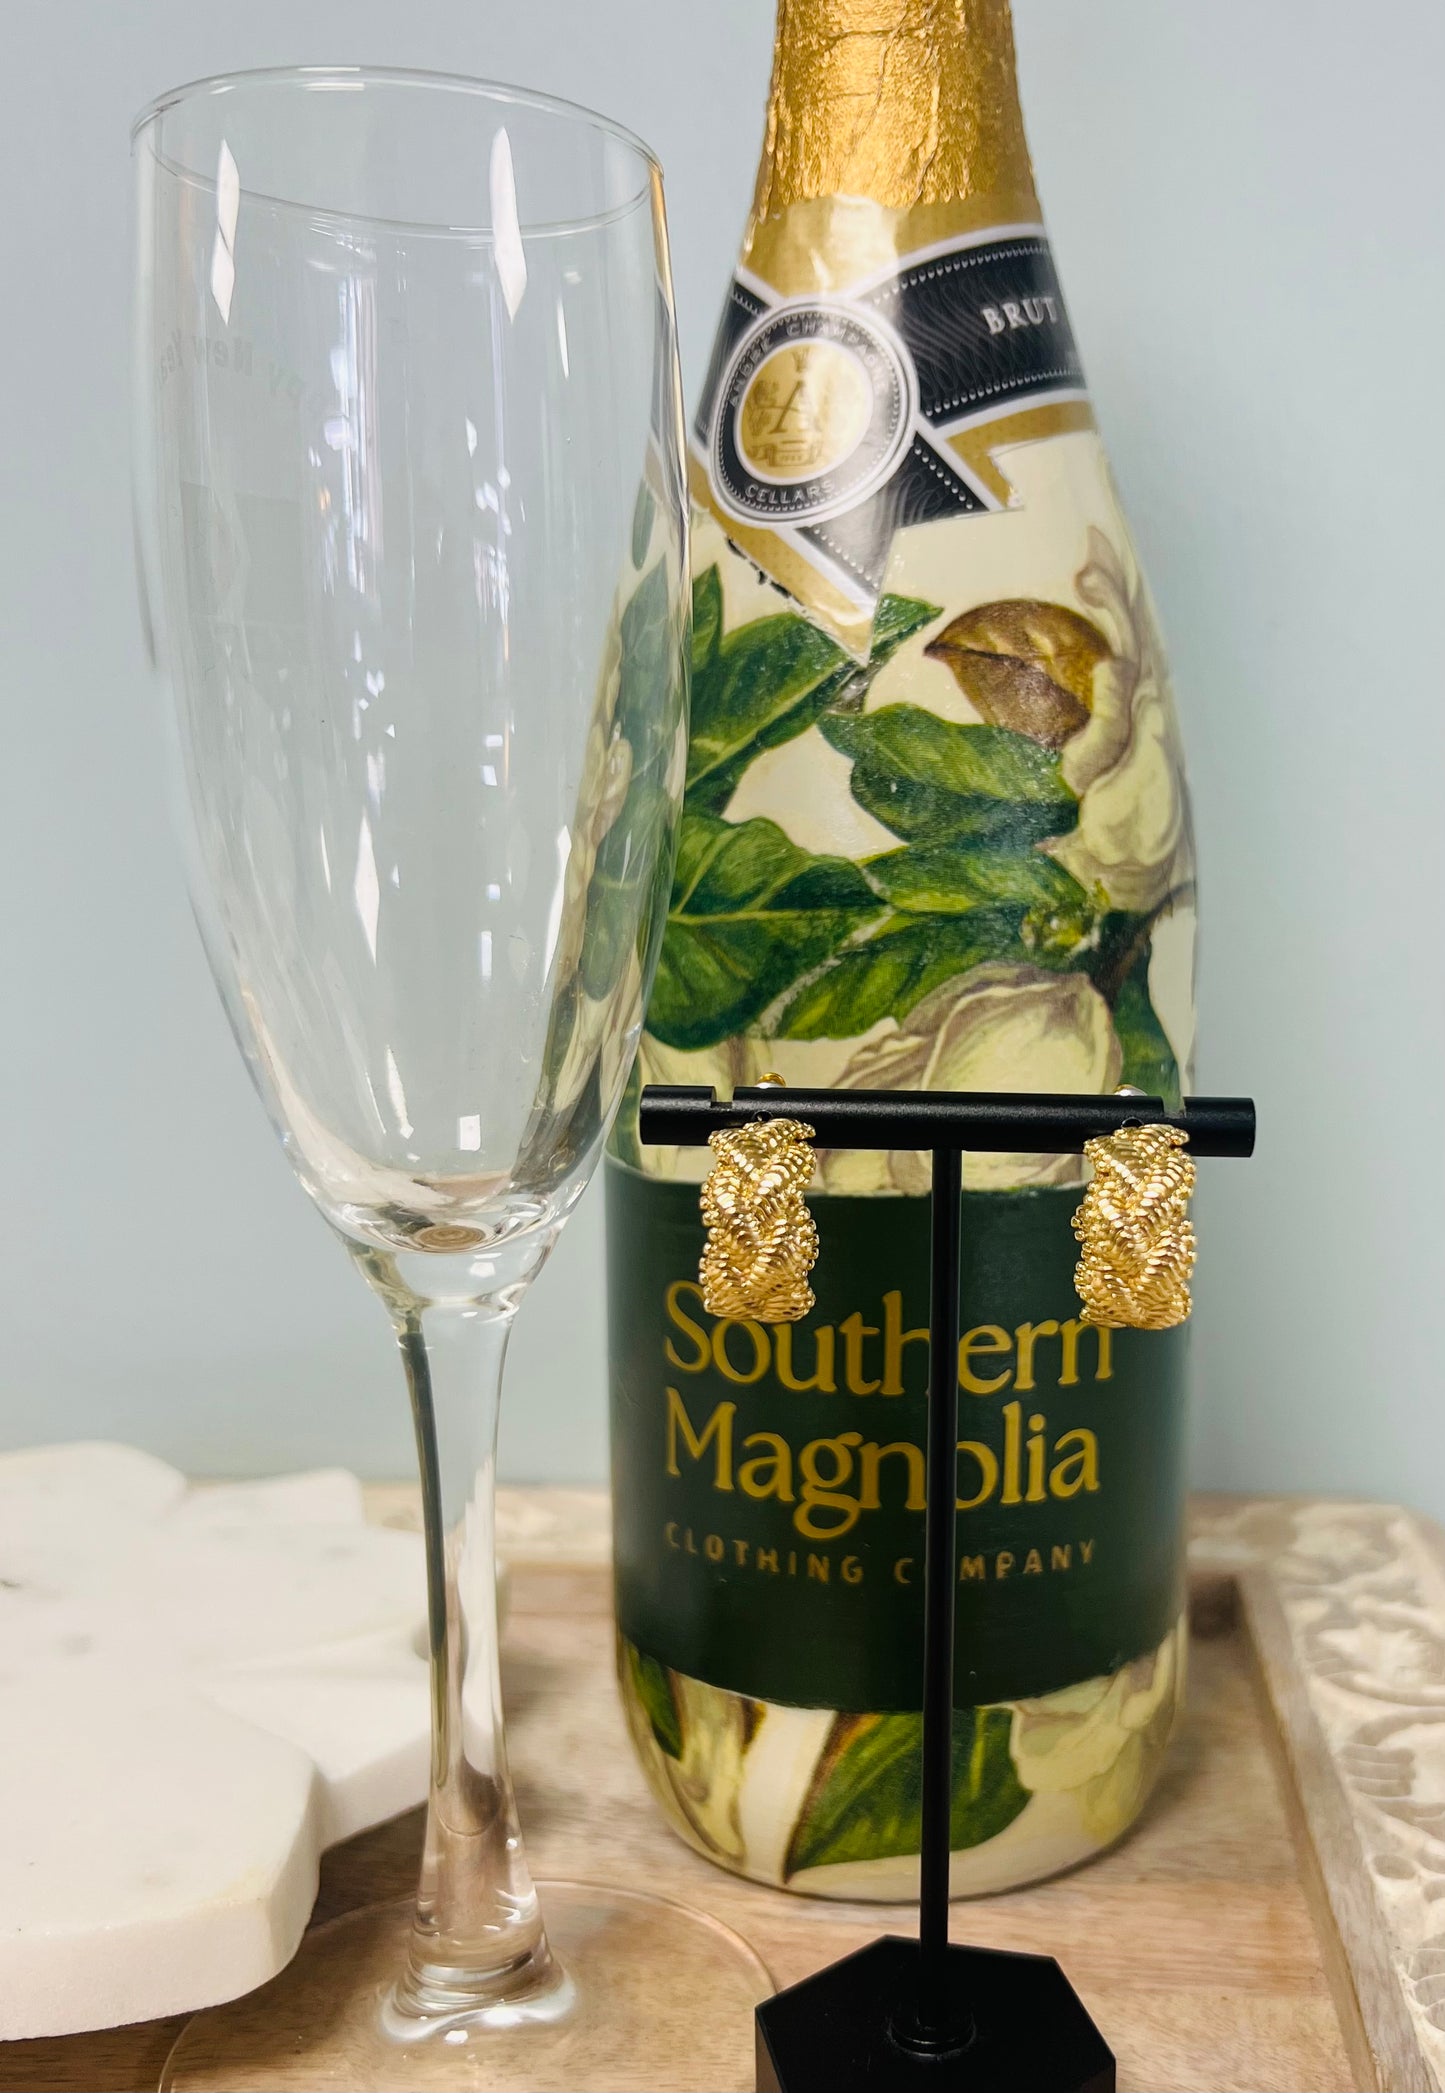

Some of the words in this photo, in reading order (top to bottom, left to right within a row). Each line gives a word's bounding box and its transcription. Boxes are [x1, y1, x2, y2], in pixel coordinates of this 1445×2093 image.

[982, 297, 1057, 335] BRUT
[745, 480, 836, 504] CELLARS
[664, 1280, 1113, 1396] Southern
[664, 1386, 1099, 1540] Magnolia
[665, 1522, 864, 1584] CLOTHING
[893, 1538, 1096, 1585] CMPANY
